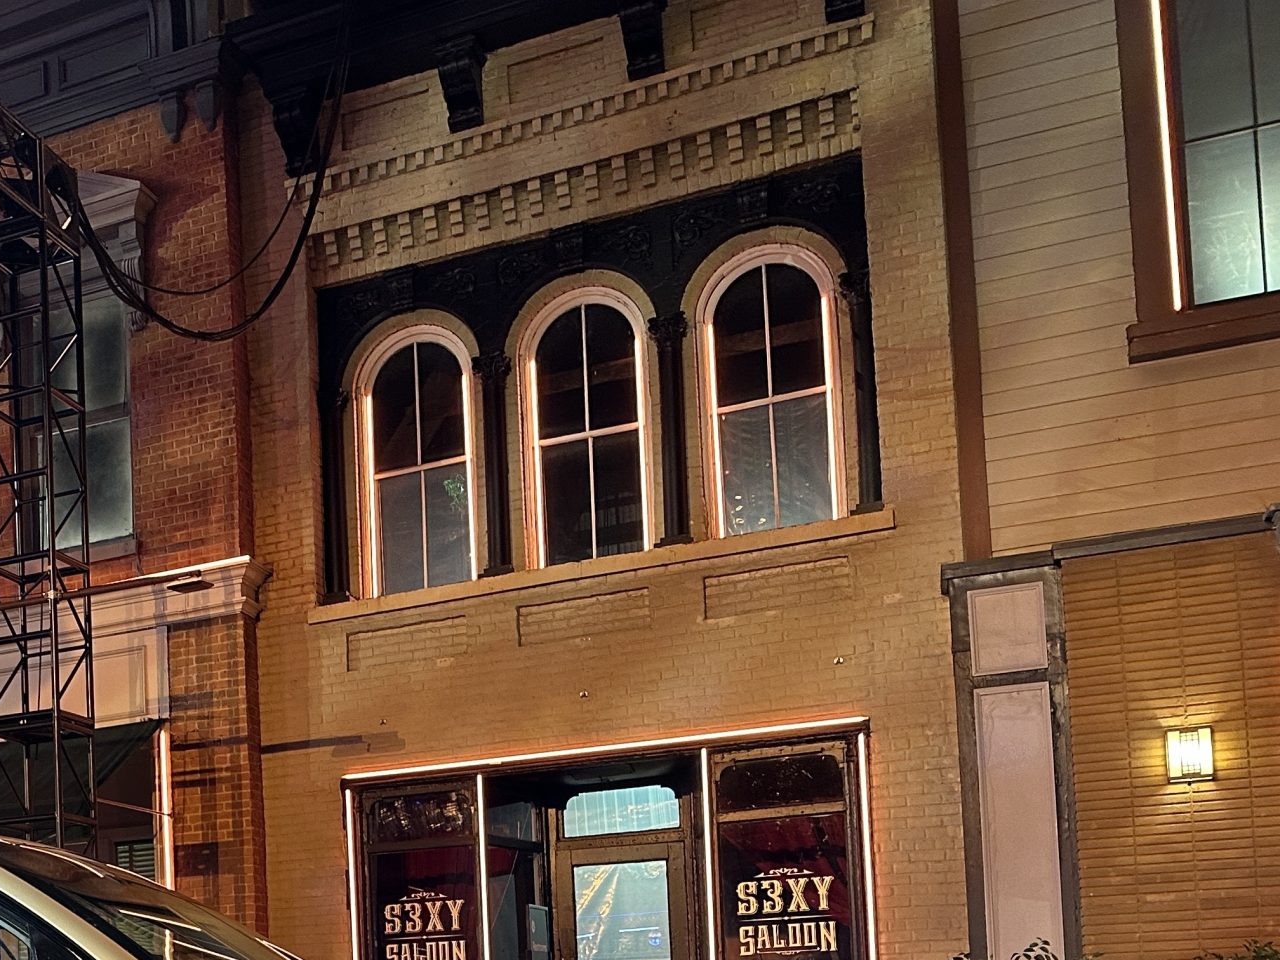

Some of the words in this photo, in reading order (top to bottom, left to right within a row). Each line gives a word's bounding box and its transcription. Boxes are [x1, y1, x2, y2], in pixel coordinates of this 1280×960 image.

[735, 876, 835, 916] S3XY
[383, 899, 465, 935] S3XY
[739, 921, 838, 956] SALOON
